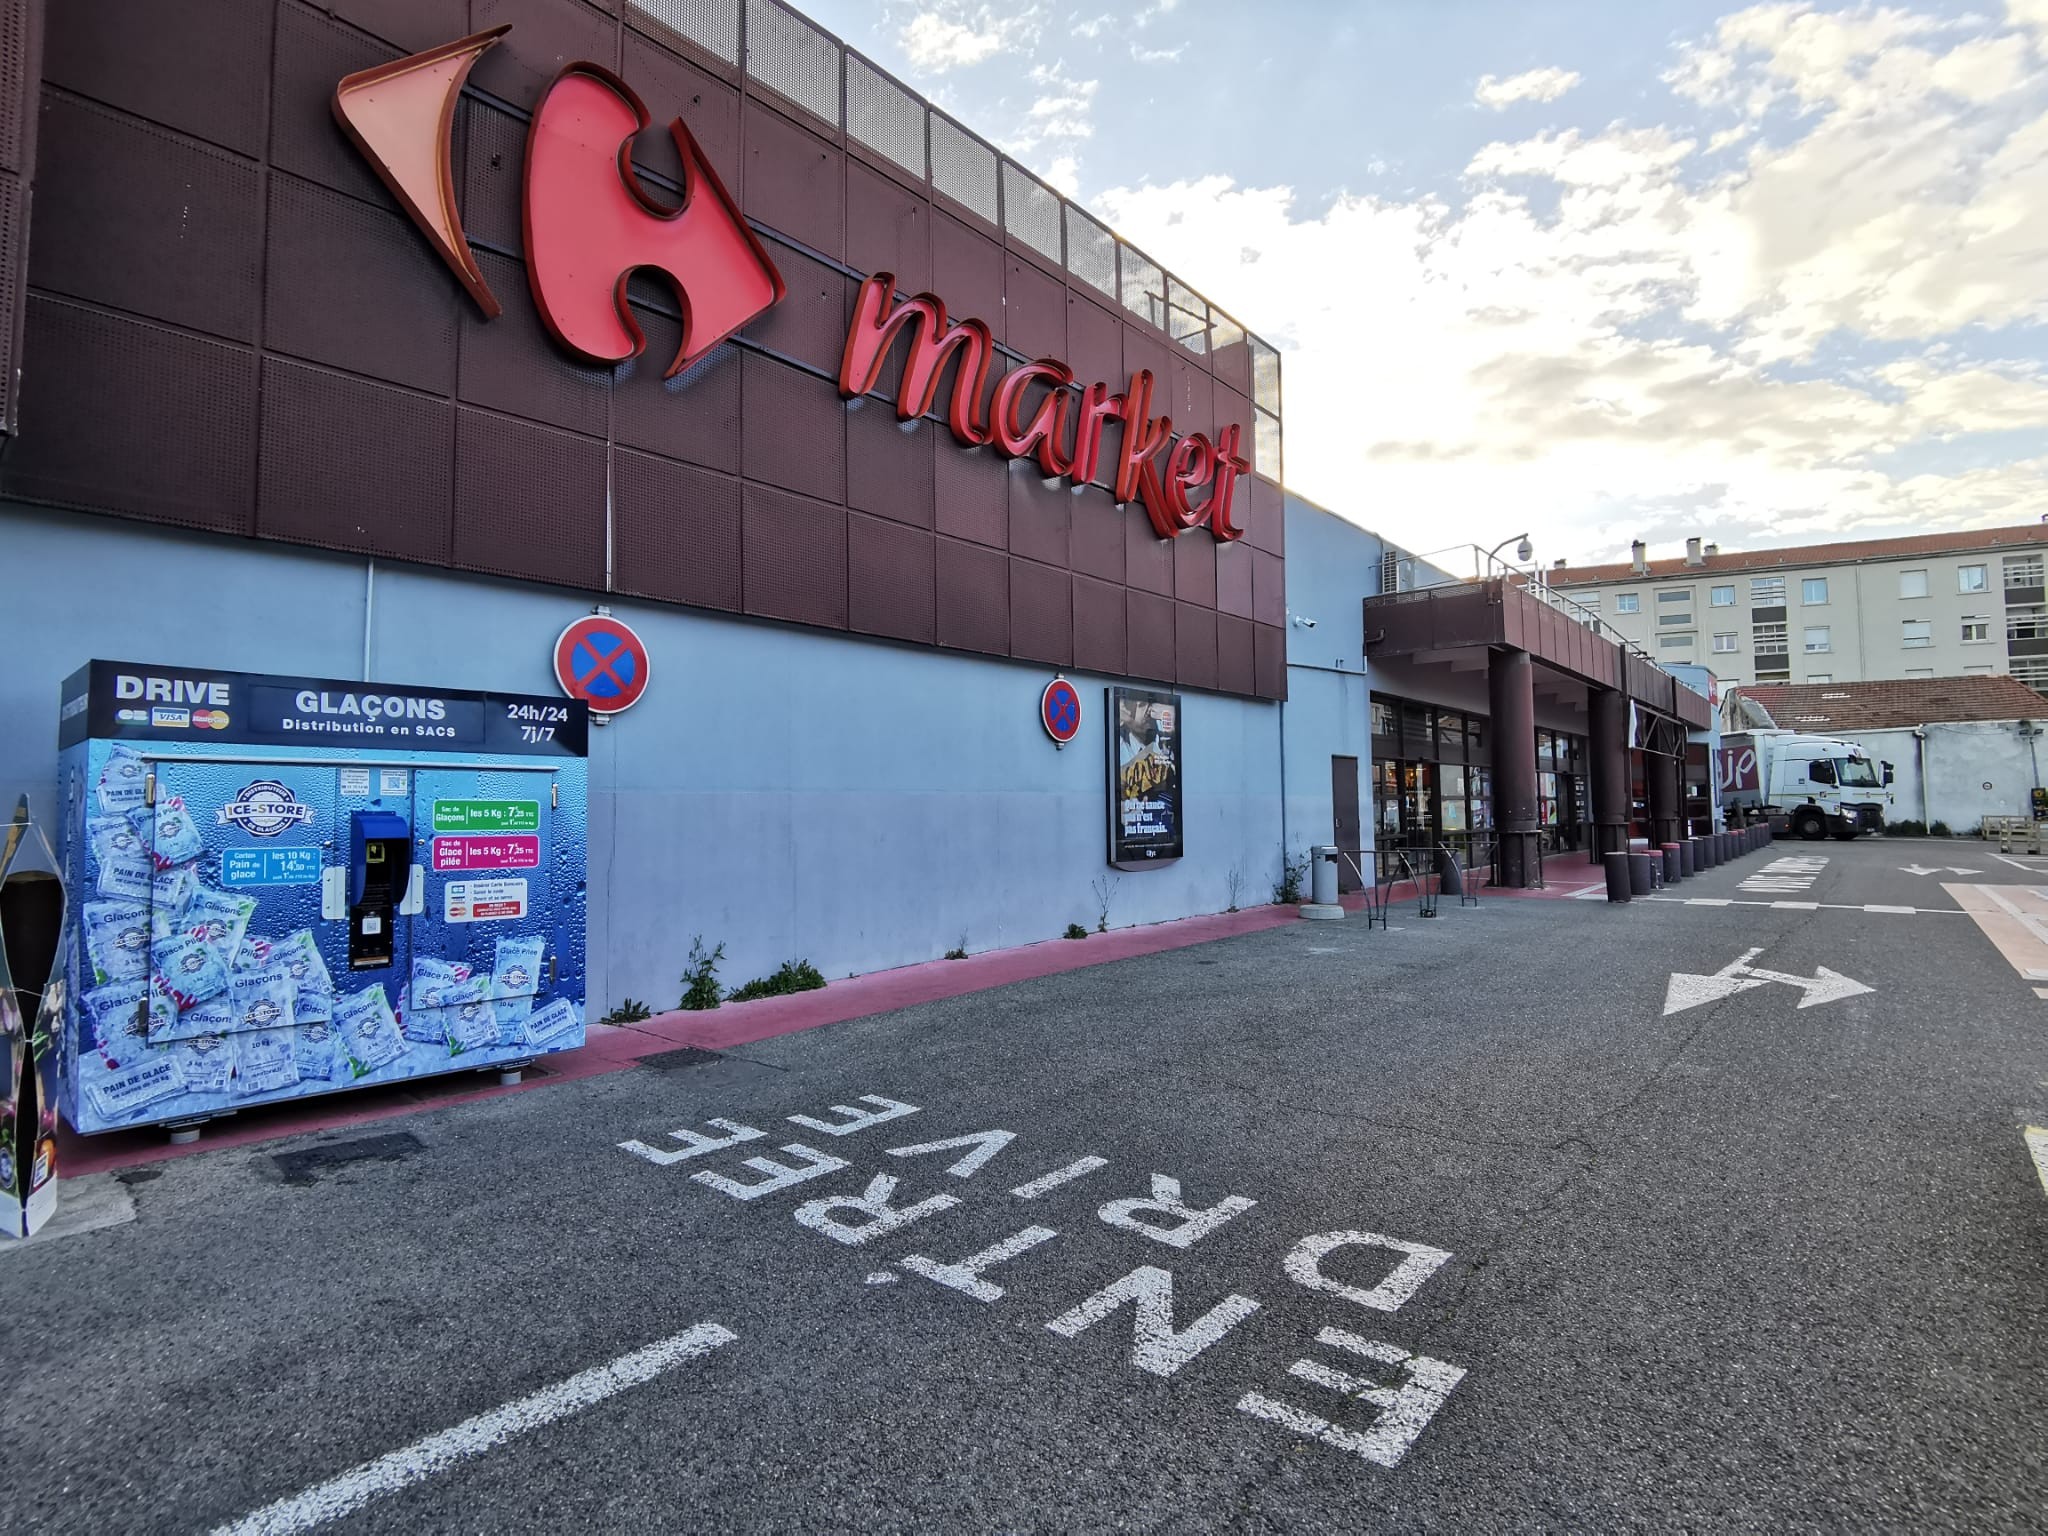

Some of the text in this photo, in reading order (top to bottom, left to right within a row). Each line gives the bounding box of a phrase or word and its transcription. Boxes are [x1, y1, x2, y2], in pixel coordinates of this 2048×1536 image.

[839, 272, 1250, 543] market
[115, 675, 230, 705] DRIVE
[296, 690, 446, 721] GLAÇONS
[507, 704, 568, 722] 24h/24
[159, 713, 183, 721] VISA
[282, 718, 456, 737] Distribution en SACS
[520, 726, 556, 743] 7j/7
[228, 803, 304, 816] ICE-STORE
[470, 808, 482, 818] les
[483, 808, 490, 817] 5
[491, 809, 502, 819] Kg
[435, 813, 465, 823] Glaçons
[272, 851, 286, 860] les
[287, 851, 297, 860] 10
[299, 850, 311, 860] Kg
[439, 847, 463, 857] Glace
[469, 846, 482, 856] les
[483, 846, 489, 855] 5
[490, 846, 501, 857] Kg
[229, 860, 250, 869] Pain
[440, 857, 461, 868] pilée
[113, 867, 133, 878] PAIN
[134, 871, 147, 880] DE
[230, 869, 257, 881] glace
[103, 909, 153, 923] Glaçons
[204, 901, 241, 916] Glaçons
[273, 943, 307, 962] Glaçons
[234, 971, 283, 989] Glaçons
[99, 993, 138, 1012] Glace
[343, 999, 378, 1020] Glaçons
[102, 1080, 127, 1095] PAIN
[127, 1076, 140, 1087] DE
[141, 1063, 172, 1081] GLACE
[789, 1094, 1455, 1312] DRIVE
